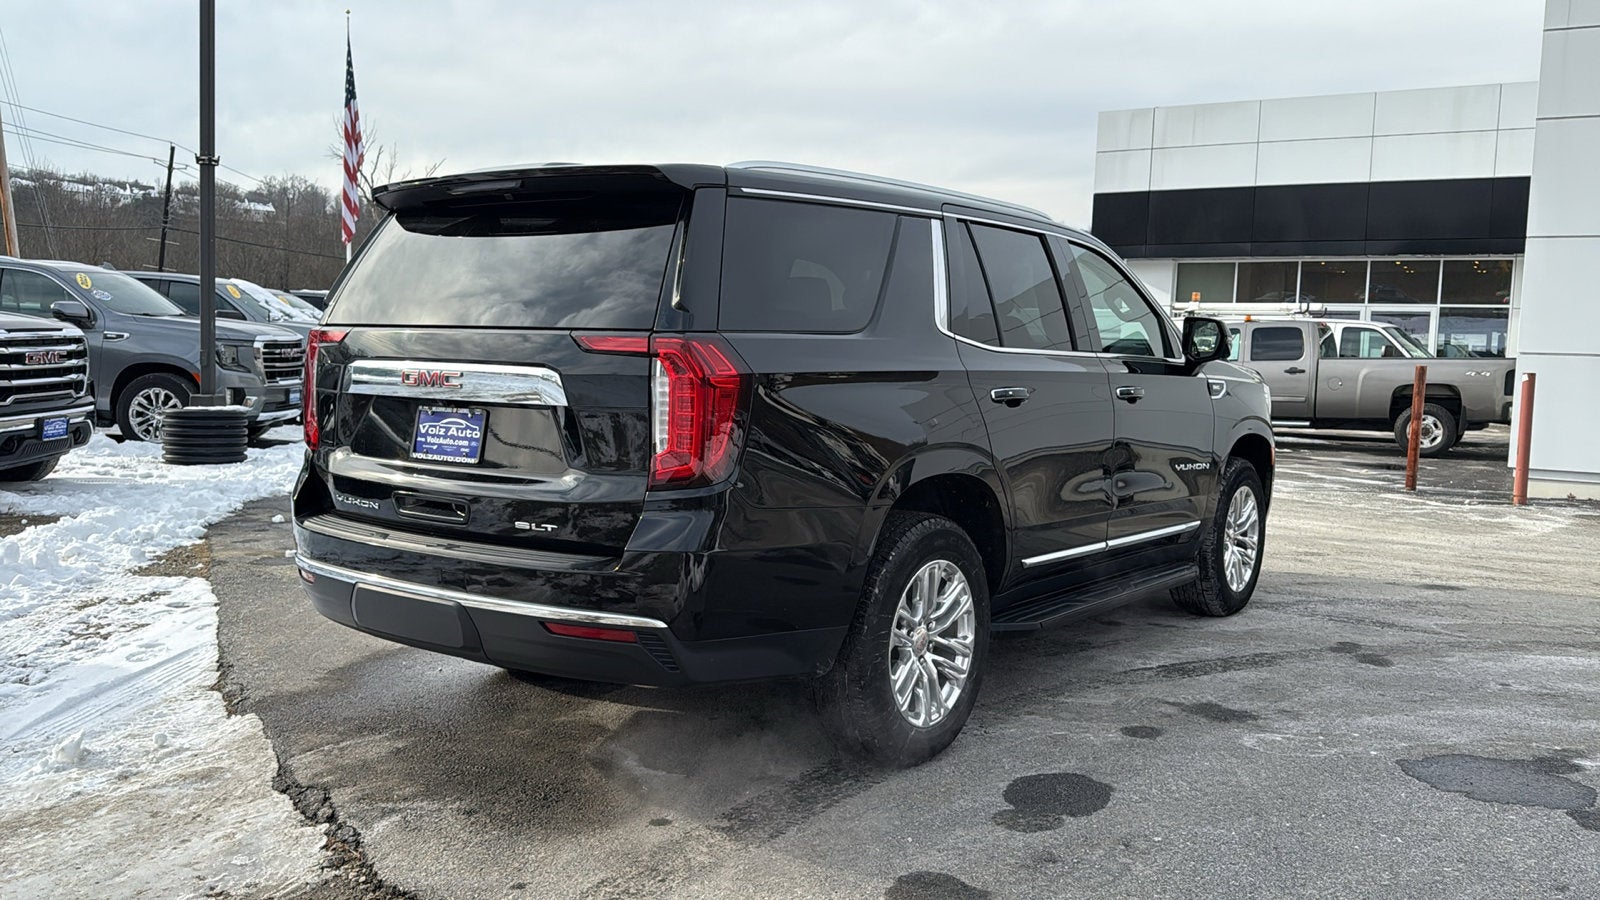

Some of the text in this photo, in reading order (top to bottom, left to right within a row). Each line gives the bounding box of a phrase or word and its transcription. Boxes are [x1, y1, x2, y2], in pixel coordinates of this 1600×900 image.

[25, 350, 68, 365] GMC
[401, 369, 462, 390] GMC
[419, 424, 480, 439] Volz Auto
[426, 436, 469, 446] VolzAuto.com
[412, 452, 475, 464] VOLZAUTO.COM
[1174, 462, 1211, 472] YUKON
[336, 494, 379, 510] YUKON
[514, 521, 559, 532] SLT
